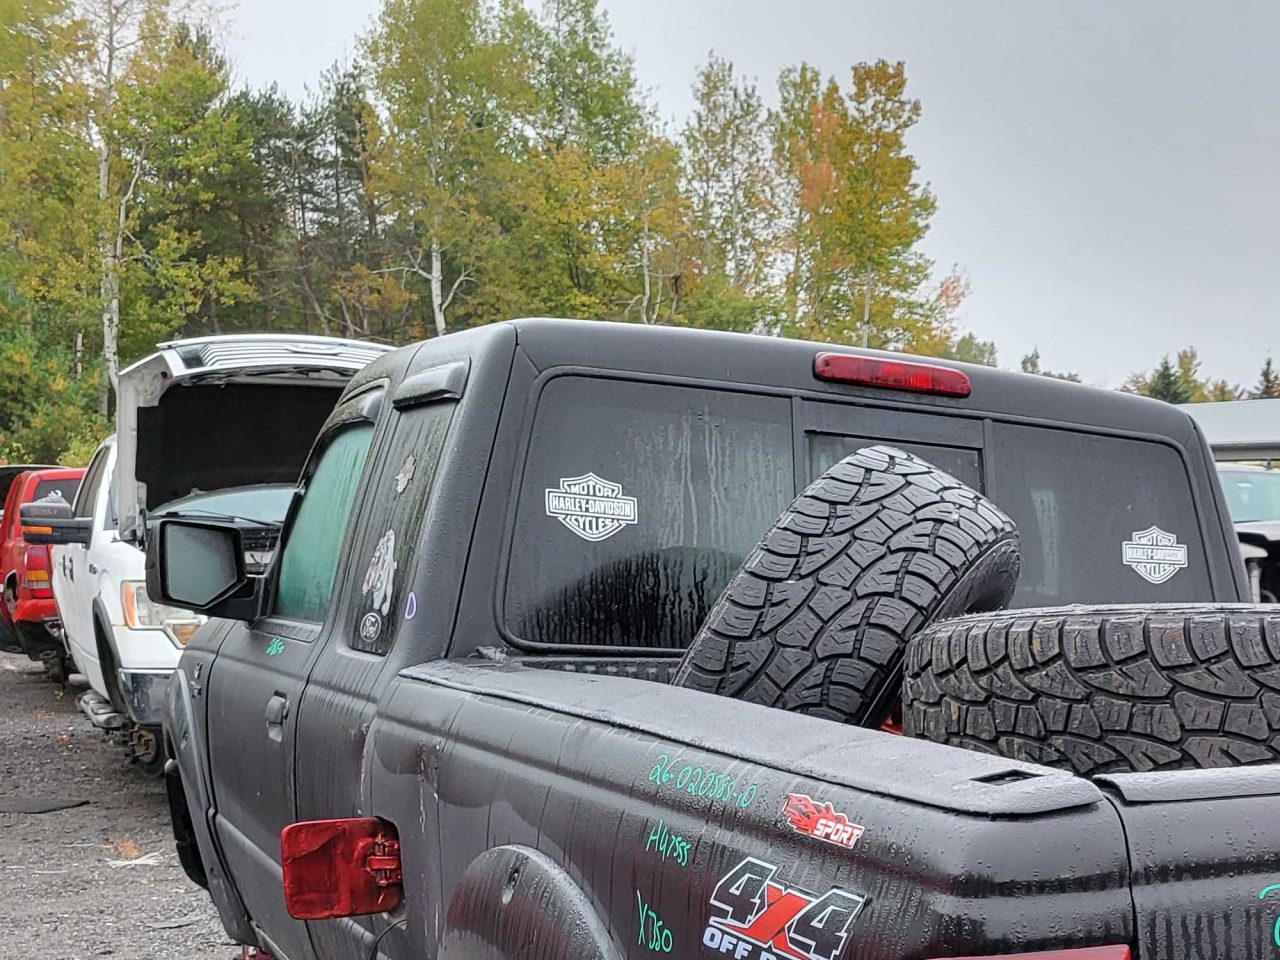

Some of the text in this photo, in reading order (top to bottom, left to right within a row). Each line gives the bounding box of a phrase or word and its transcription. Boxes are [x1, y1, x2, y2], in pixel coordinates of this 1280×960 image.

[570, 481, 612, 497] MOTOR
[552, 496, 631, 516] HARLEY-DAVIDSON
[570, 515, 613, 535] CYCLES
[812, 818, 864, 847] SPORT
[702, 926, 752, 960] OFF
